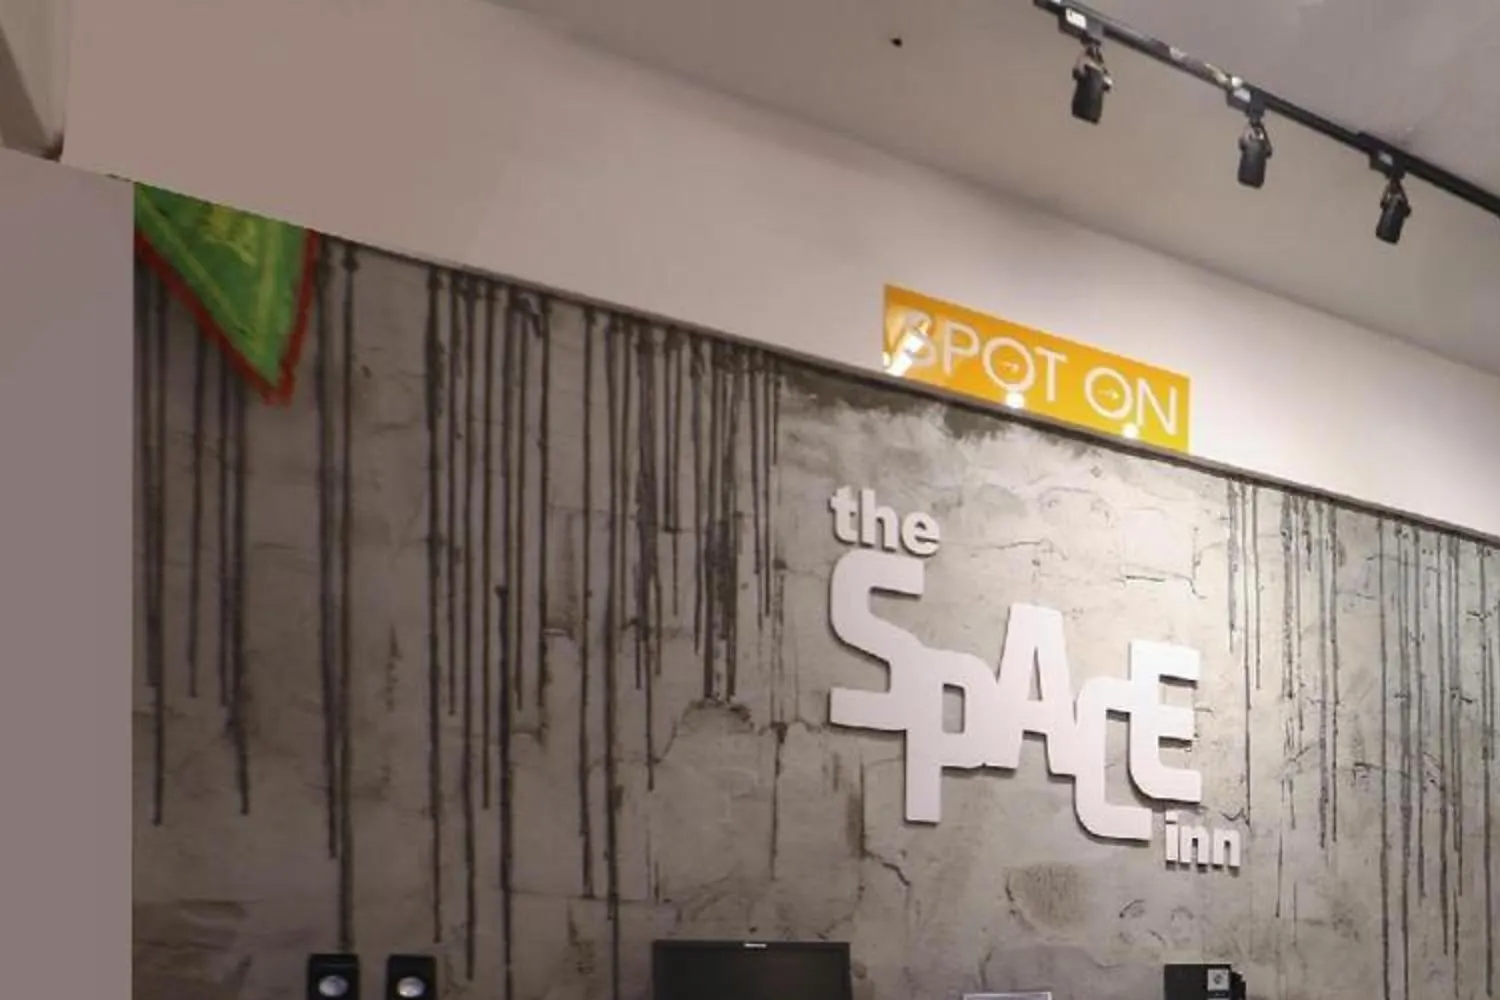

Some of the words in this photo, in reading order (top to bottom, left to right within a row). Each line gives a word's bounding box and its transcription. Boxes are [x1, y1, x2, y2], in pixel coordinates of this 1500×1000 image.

[898, 310, 1068, 402] SPOT
[1084, 366, 1178, 435] ON
[830, 486, 940, 556] the
[1163, 810, 1241, 868] inn
